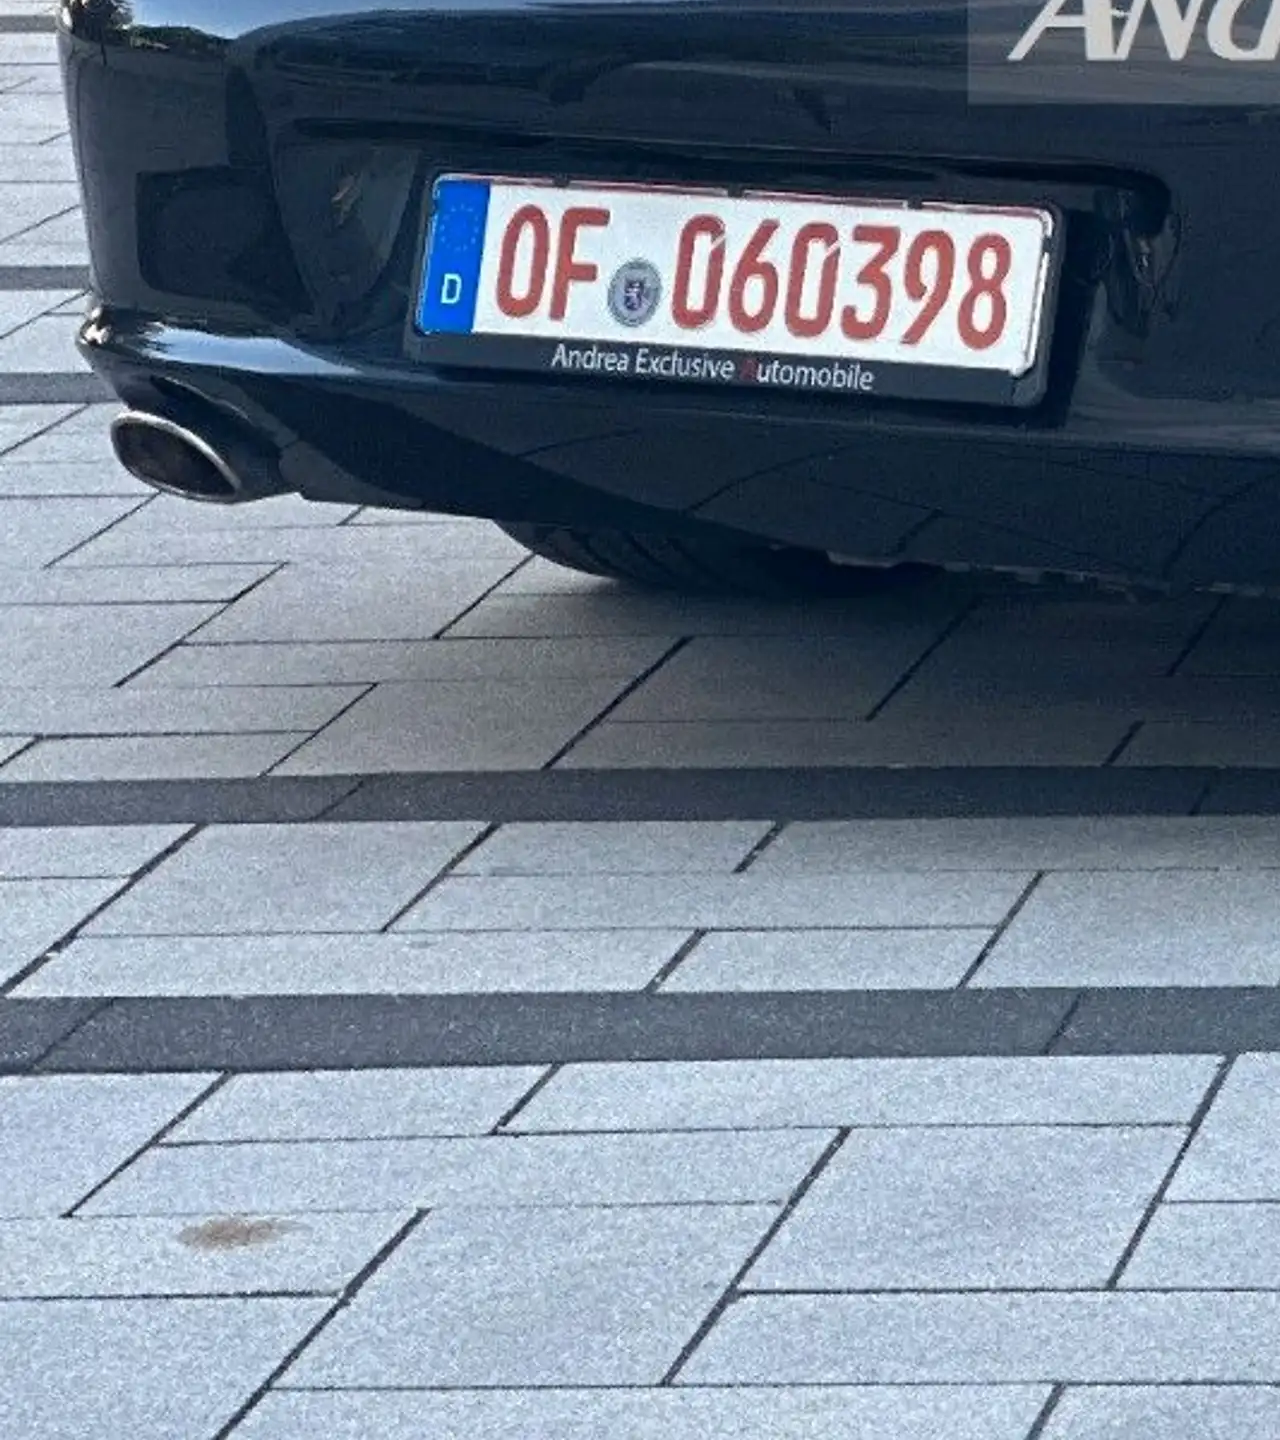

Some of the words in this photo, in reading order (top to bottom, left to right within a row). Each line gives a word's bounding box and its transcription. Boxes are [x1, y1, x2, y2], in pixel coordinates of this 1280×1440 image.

[440, 273, 463, 304] D
[496, 204, 610, 320] OF
[671, 213, 1012, 349] 060398
[551, 343, 630, 372] Andrea
[635, 347, 736, 379] Exclusive
